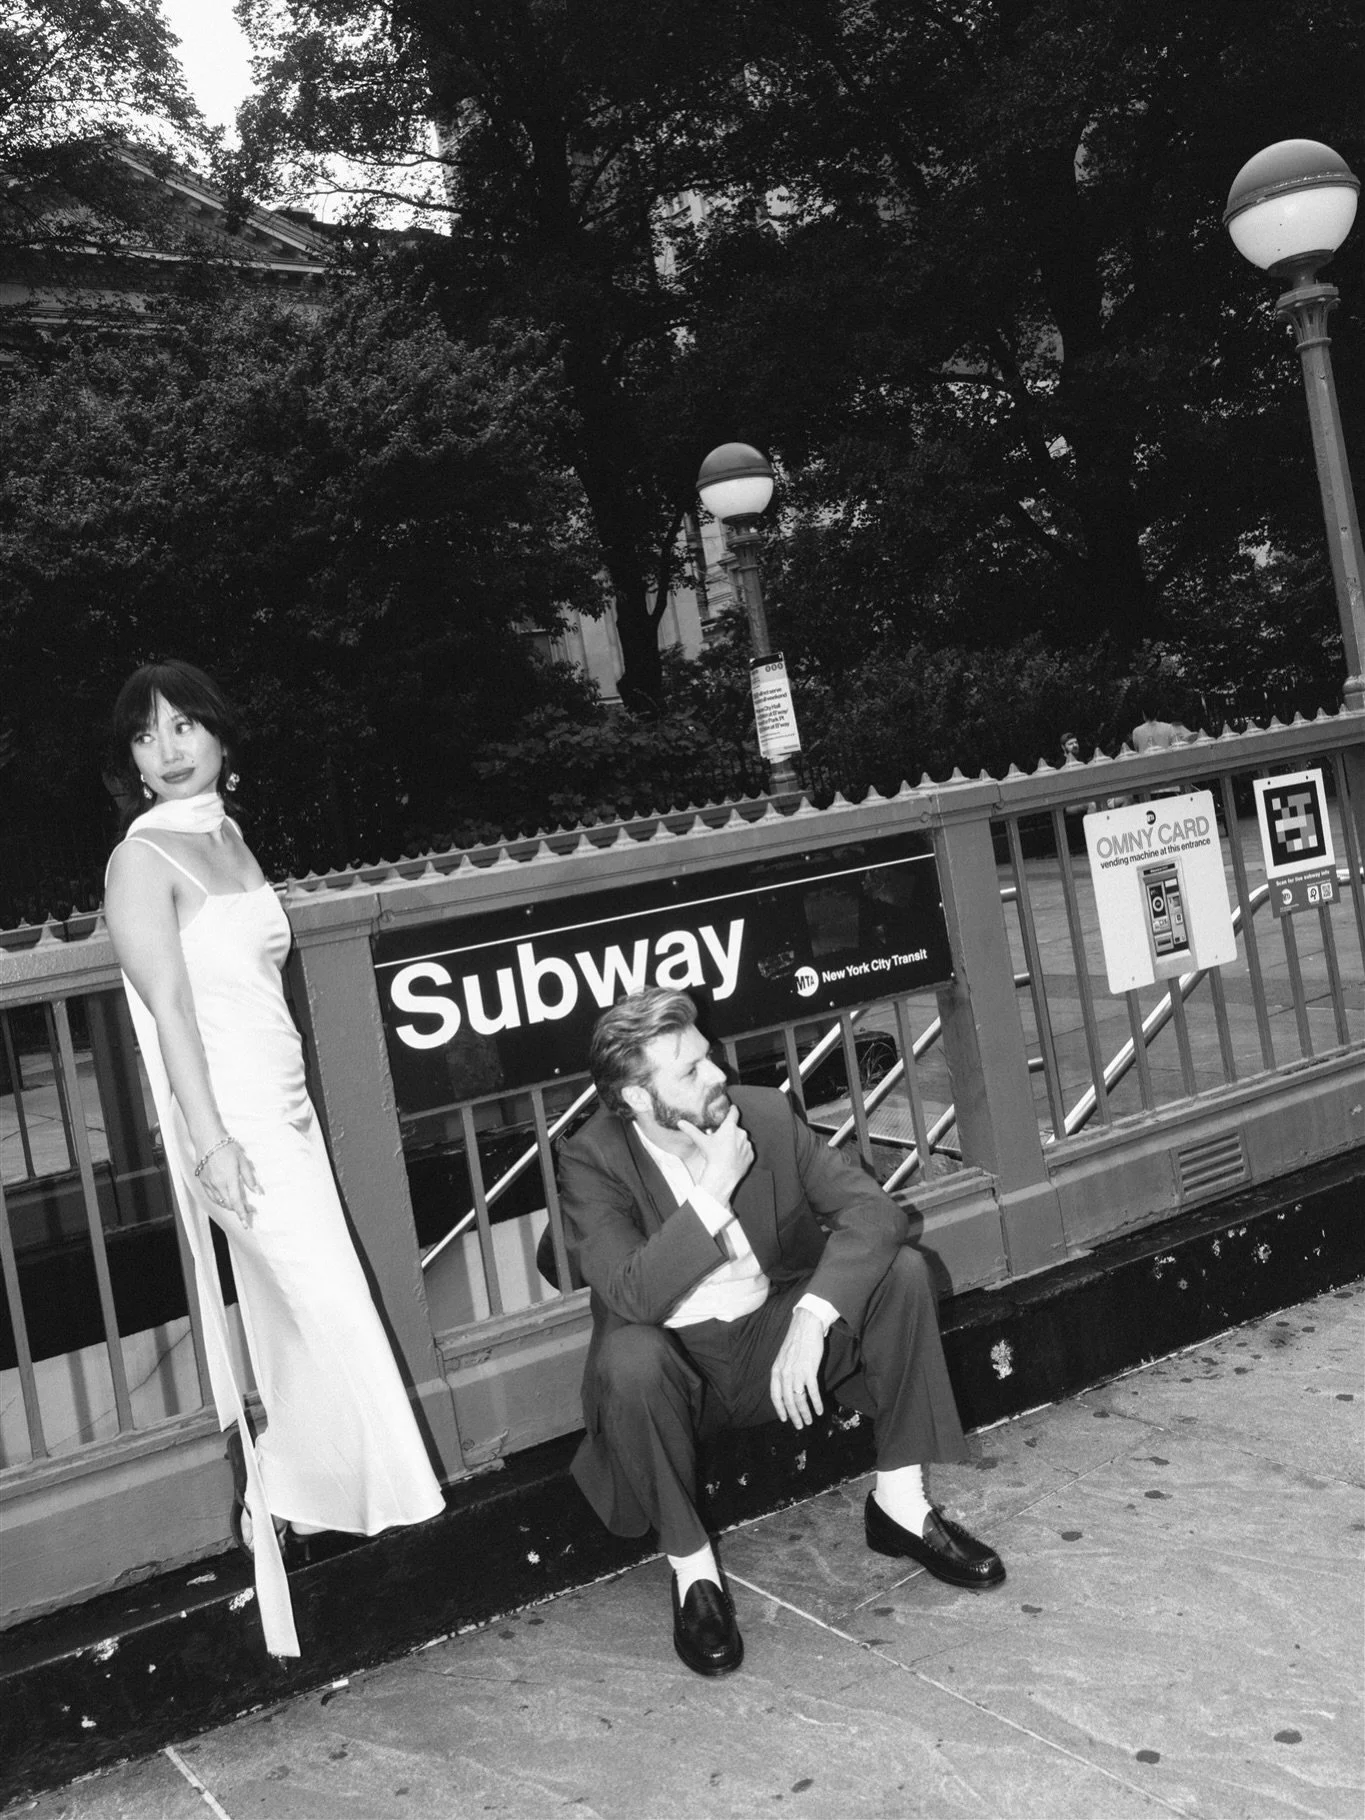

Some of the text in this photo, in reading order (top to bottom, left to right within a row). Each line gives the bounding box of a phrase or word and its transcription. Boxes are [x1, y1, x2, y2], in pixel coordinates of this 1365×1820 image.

[1096, 816, 1210, 859] OMNY CARD
[1100, 838, 1211, 870] vending machine at this entrance
[795, 971, 817, 993] MTA
[821, 948, 928, 983] New York City Transit
[390, 918, 745, 1050] Subway
